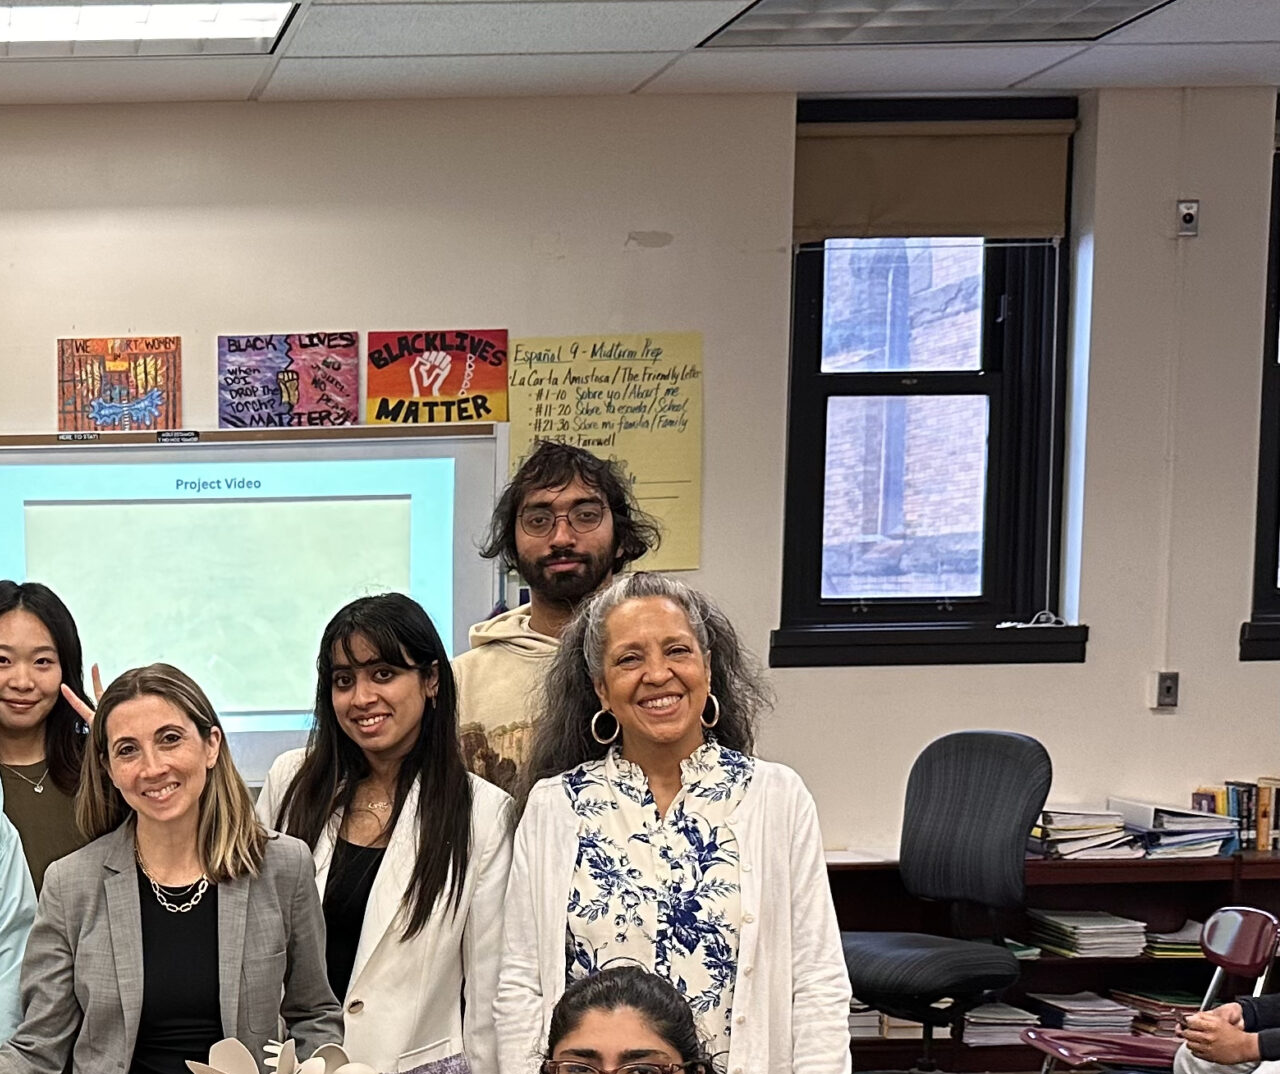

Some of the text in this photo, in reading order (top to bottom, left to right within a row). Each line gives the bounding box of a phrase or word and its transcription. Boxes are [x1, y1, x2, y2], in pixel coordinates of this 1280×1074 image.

[75, 340, 91, 354] WE
[227, 333, 355, 352] BLACK LIVES
[514, 344, 561, 368] Español
[570, 342, 579, 359] 9
[590, 343, 637, 360] Midterm
[641, 338, 663, 365] Prep
[510, 370, 525, 387] La
[527, 369, 559, 386] Carta
[229, 386, 259, 399] DROP
[375, 396, 492, 423] MATTER
[175, 477, 262, 492] Project Video
